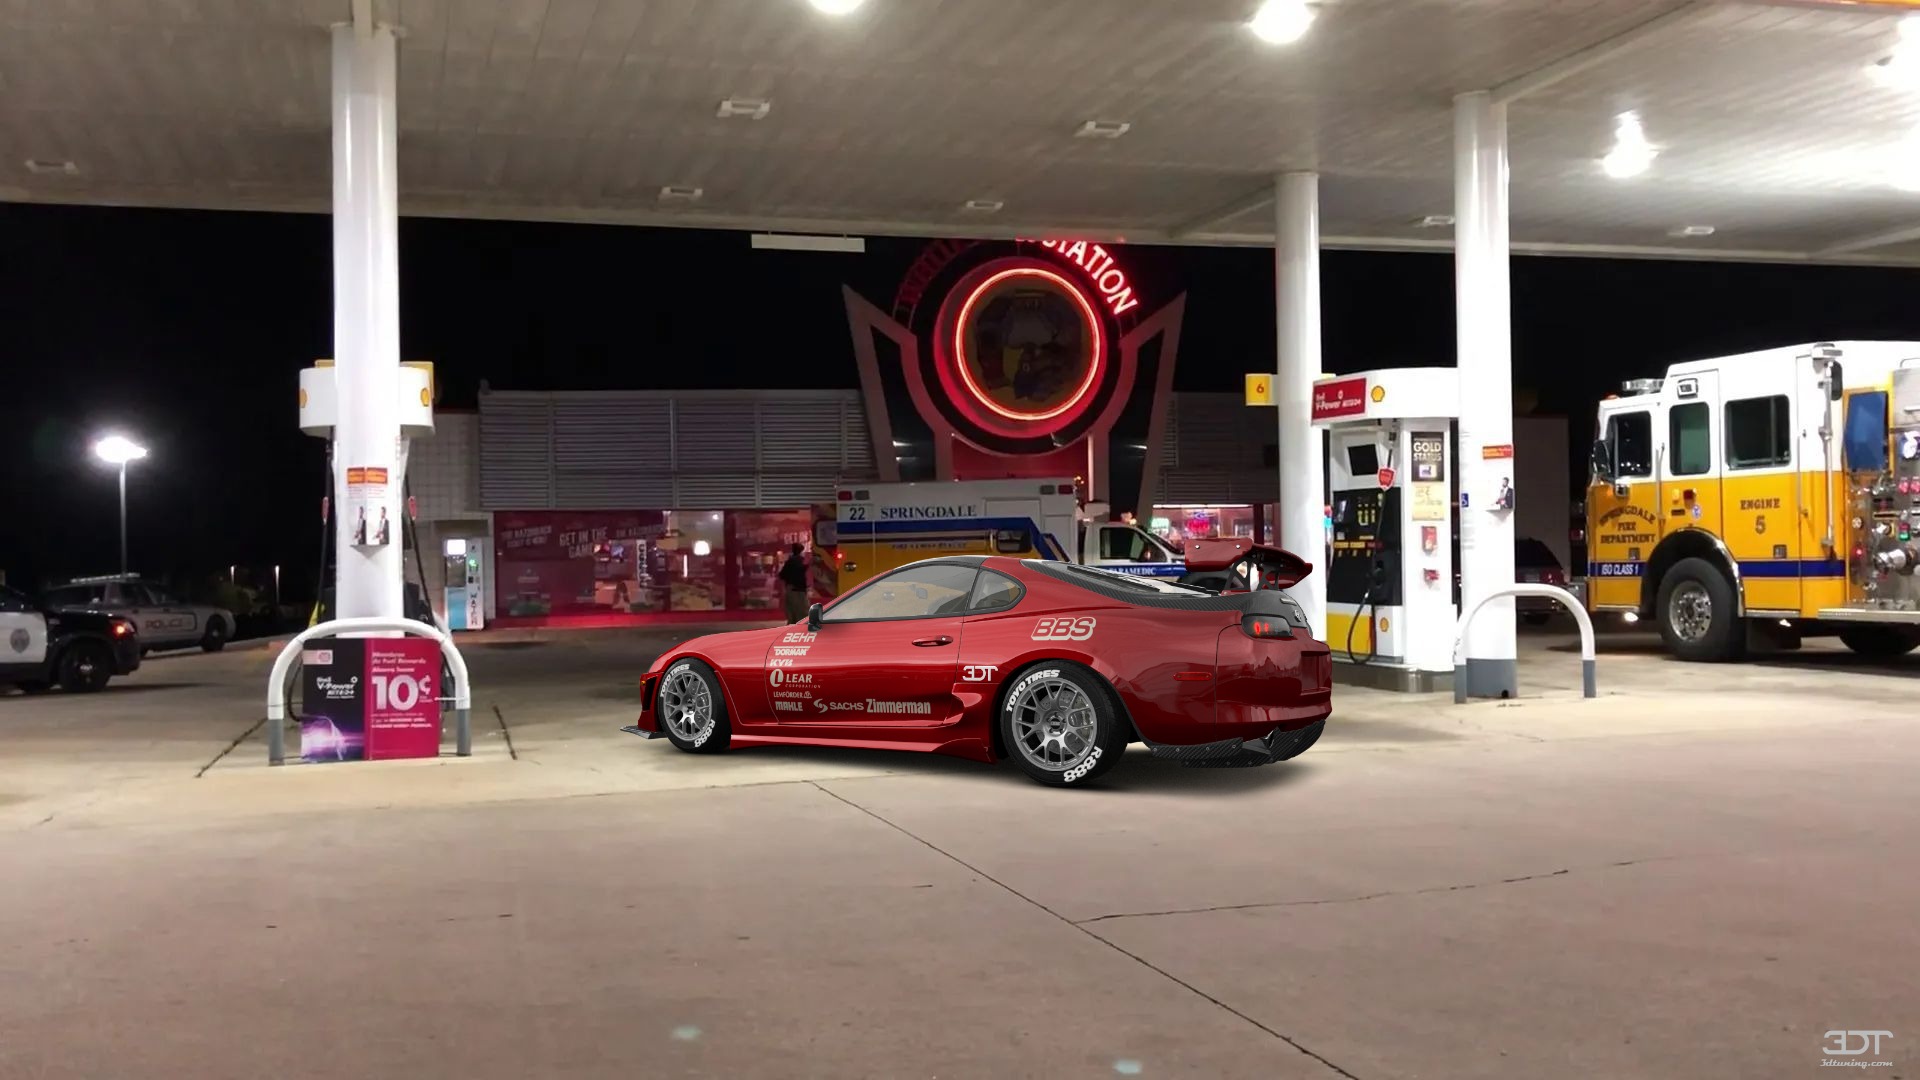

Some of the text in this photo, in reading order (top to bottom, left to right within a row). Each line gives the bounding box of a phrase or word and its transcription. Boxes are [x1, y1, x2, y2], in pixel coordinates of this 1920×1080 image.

[1256, 383, 1265, 394] 6
[1413, 442, 1442, 453] GOLD
[1413, 453, 1442, 462] STATUS
[1740, 498, 1780, 511] ENGINE
[849, 507, 865, 521] 22
[880, 505, 978, 520] SPRINGDALE
[1755, 515, 1765, 535] 5
[559, 530, 576, 547] GET
[578, 529, 589, 544] IN
[1600, 534, 1656, 544] DEPARTMENT
[1601, 564, 1612, 575] ISO
[1613, 564, 1634, 575] CLASS
[1031, 616, 1097, 641] BBS
[782, 632, 818, 643] BEHR
[774, 647, 809, 656] DORMAN
[770, 659, 794, 667] KYB
[670, 664, 690, 676] TIRES
[962, 666, 999, 682] 3DT
[785, 673, 813, 684] LEAR
[1006, 669, 1061, 712] TOYO TIRES
[775, 701, 804, 712] MAHLE
[829, 702, 864, 711] SACHS
[866, 699, 931, 715] Zimmerman
[694, 719, 716, 748] R888
[1063, 745, 1102, 783] R888
